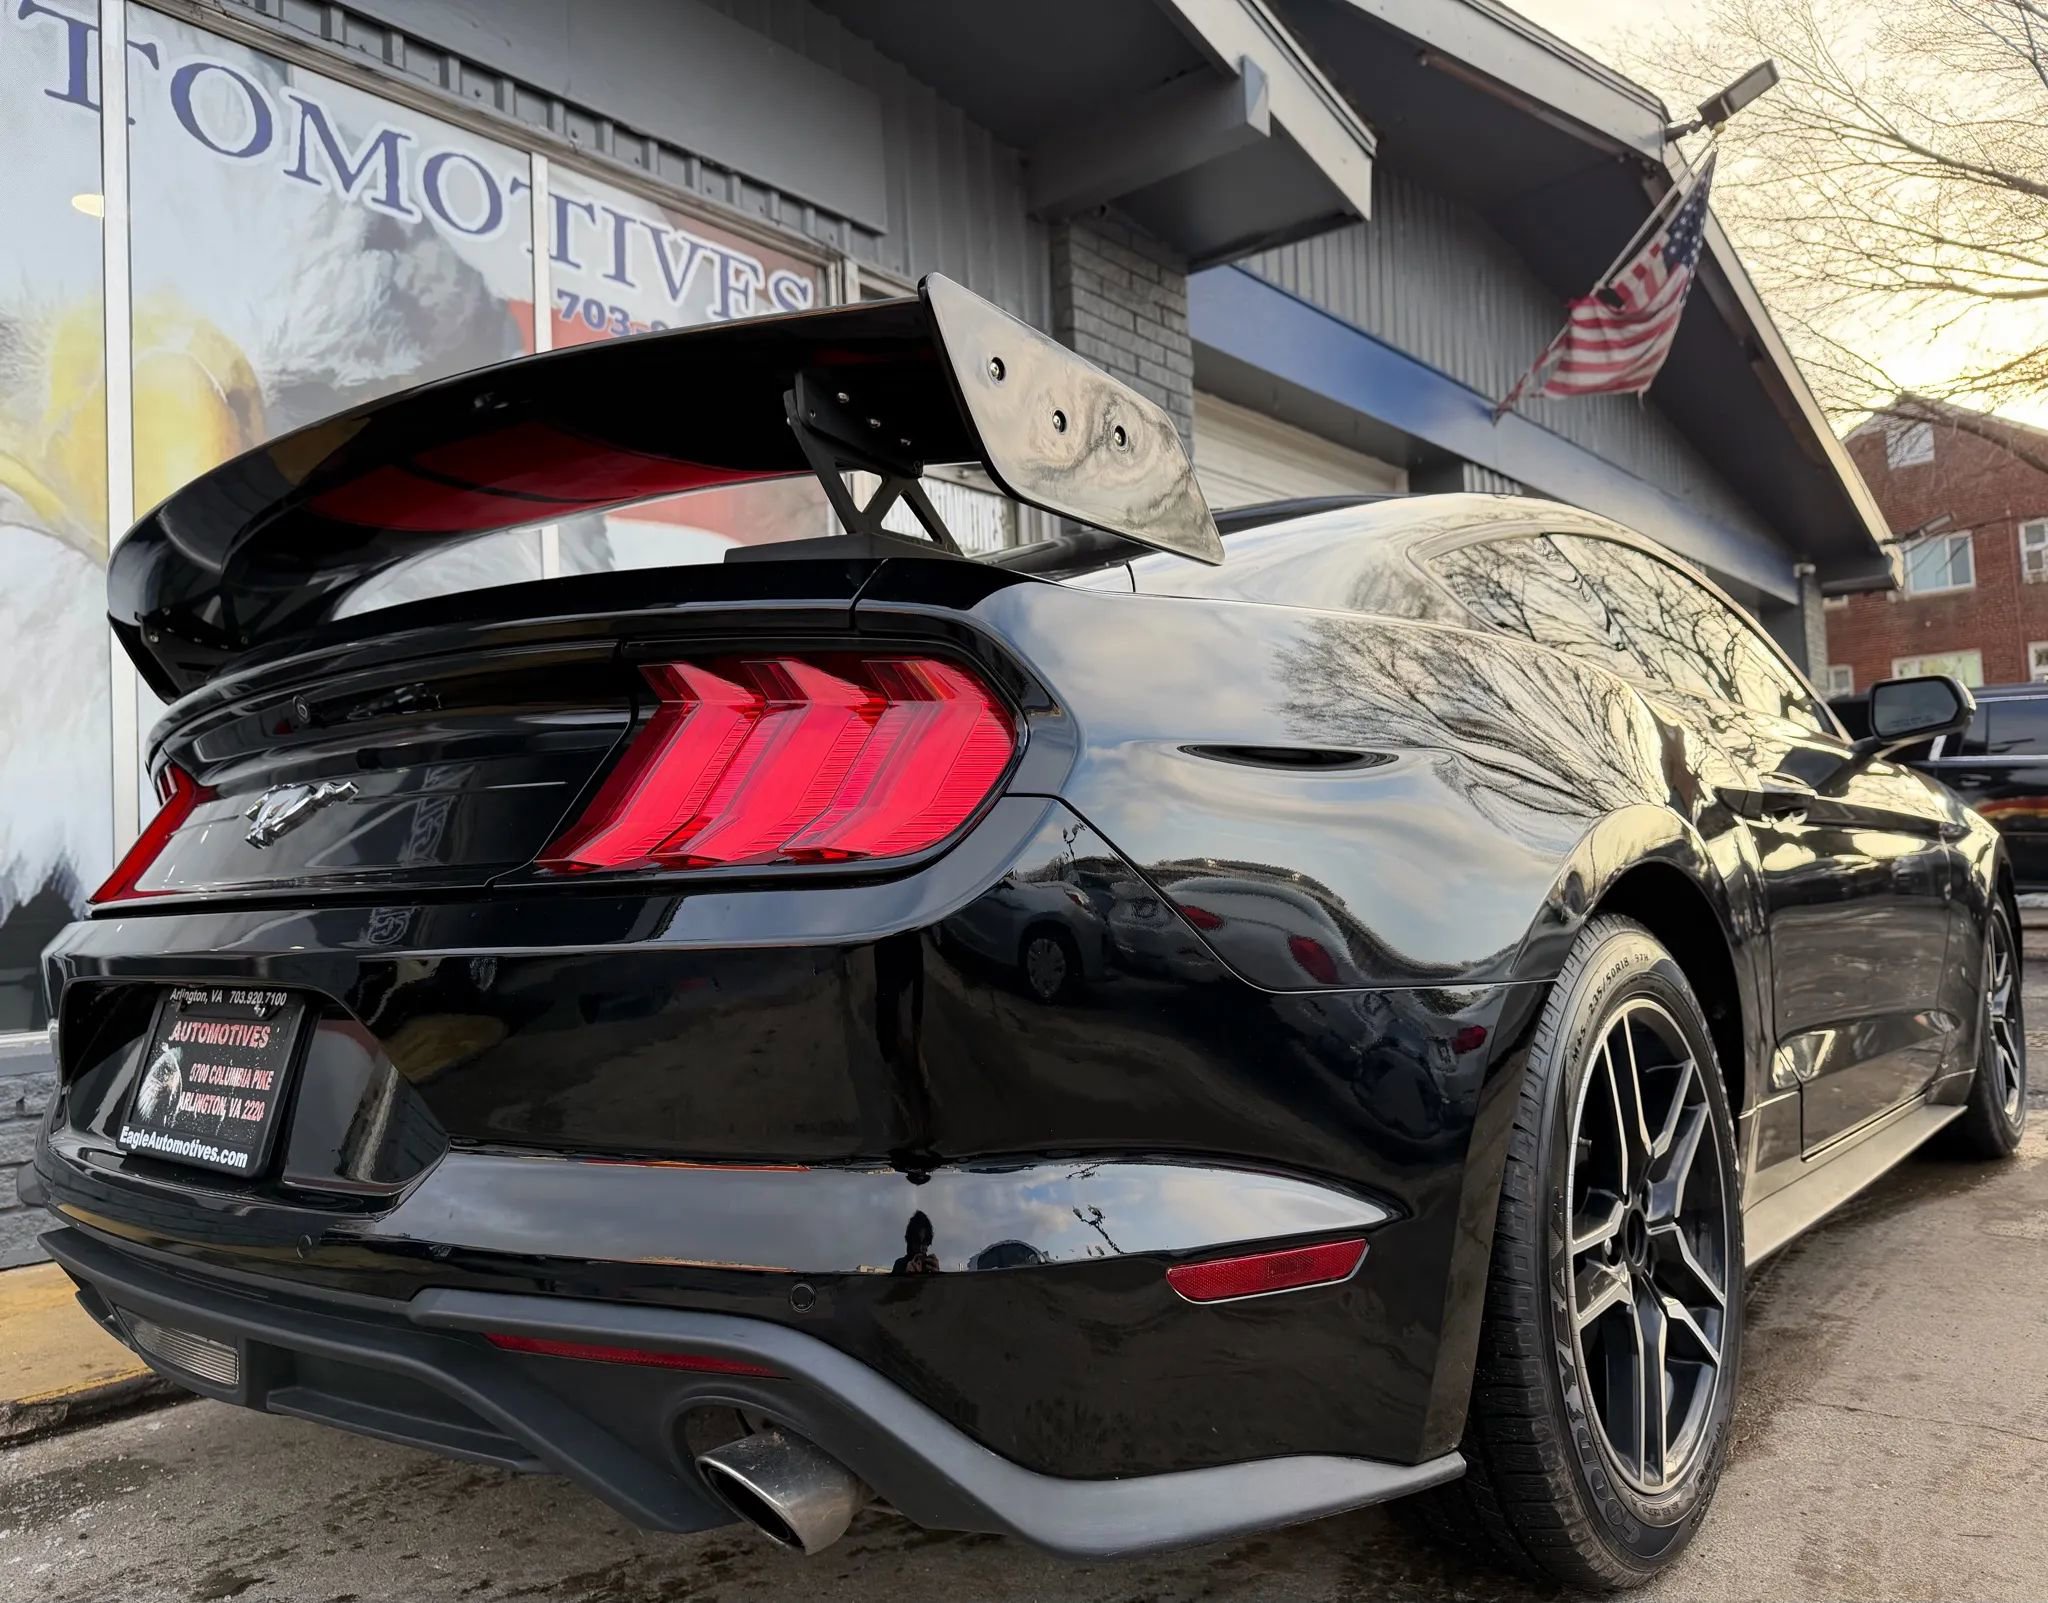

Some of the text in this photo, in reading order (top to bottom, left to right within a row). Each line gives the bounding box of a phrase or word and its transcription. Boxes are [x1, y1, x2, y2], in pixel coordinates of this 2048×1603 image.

[169, 988, 288, 1006] Arlington, VA 703.920.7100
[1588, 957, 1630, 1016] 235/50R18
[168, 1020, 271, 1048] AUTOMOTIVES
[208, 1064, 253, 1089] COLUMBIA
[251, 1069, 275, 1091] PIKE
[228, 1097, 243, 1118] VA
[119, 1125, 249, 1168] EagleAutomotives.com
